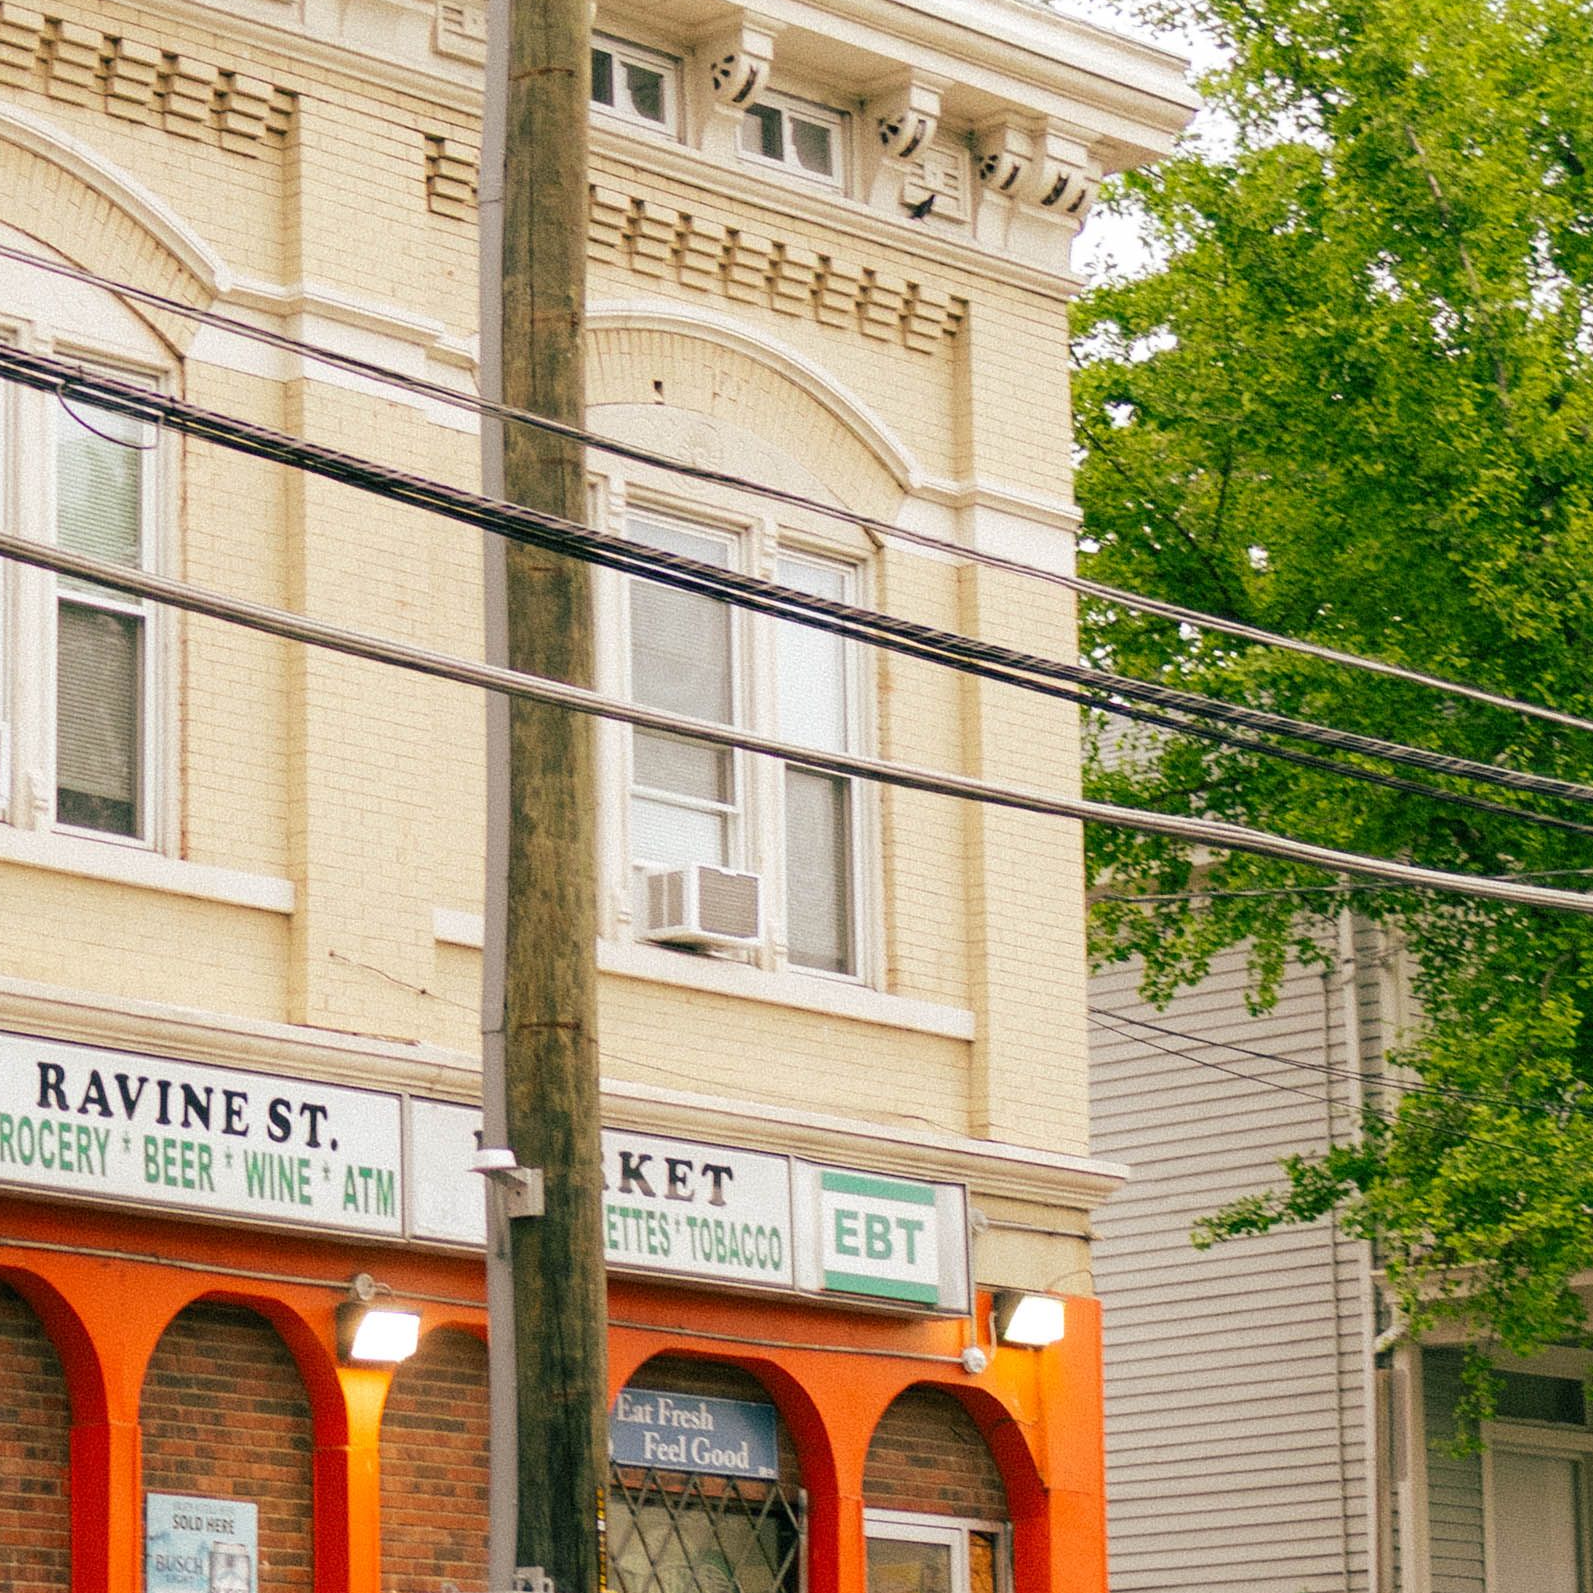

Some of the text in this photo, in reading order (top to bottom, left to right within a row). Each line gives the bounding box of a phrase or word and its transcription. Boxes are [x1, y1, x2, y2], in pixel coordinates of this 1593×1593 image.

[37, 1060, 339, 1152] RAVINE ST.
[143, 1134, 215, 1193] BEER
[243, 1148, 313, 1206] WINE
[343, 1166, 397, 1218] ATM
[605, 1203, 784, 1272] ETTES TOBACCO
[834, 1207, 924, 1265] EBT
[615, 1393, 715, 1431] Eat Fresh
[642, 1430, 751, 1470] Feel Good
[172, 1514, 235, 1535] SOLD HERE
[155, 1553, 204, 1575] BUSCH
